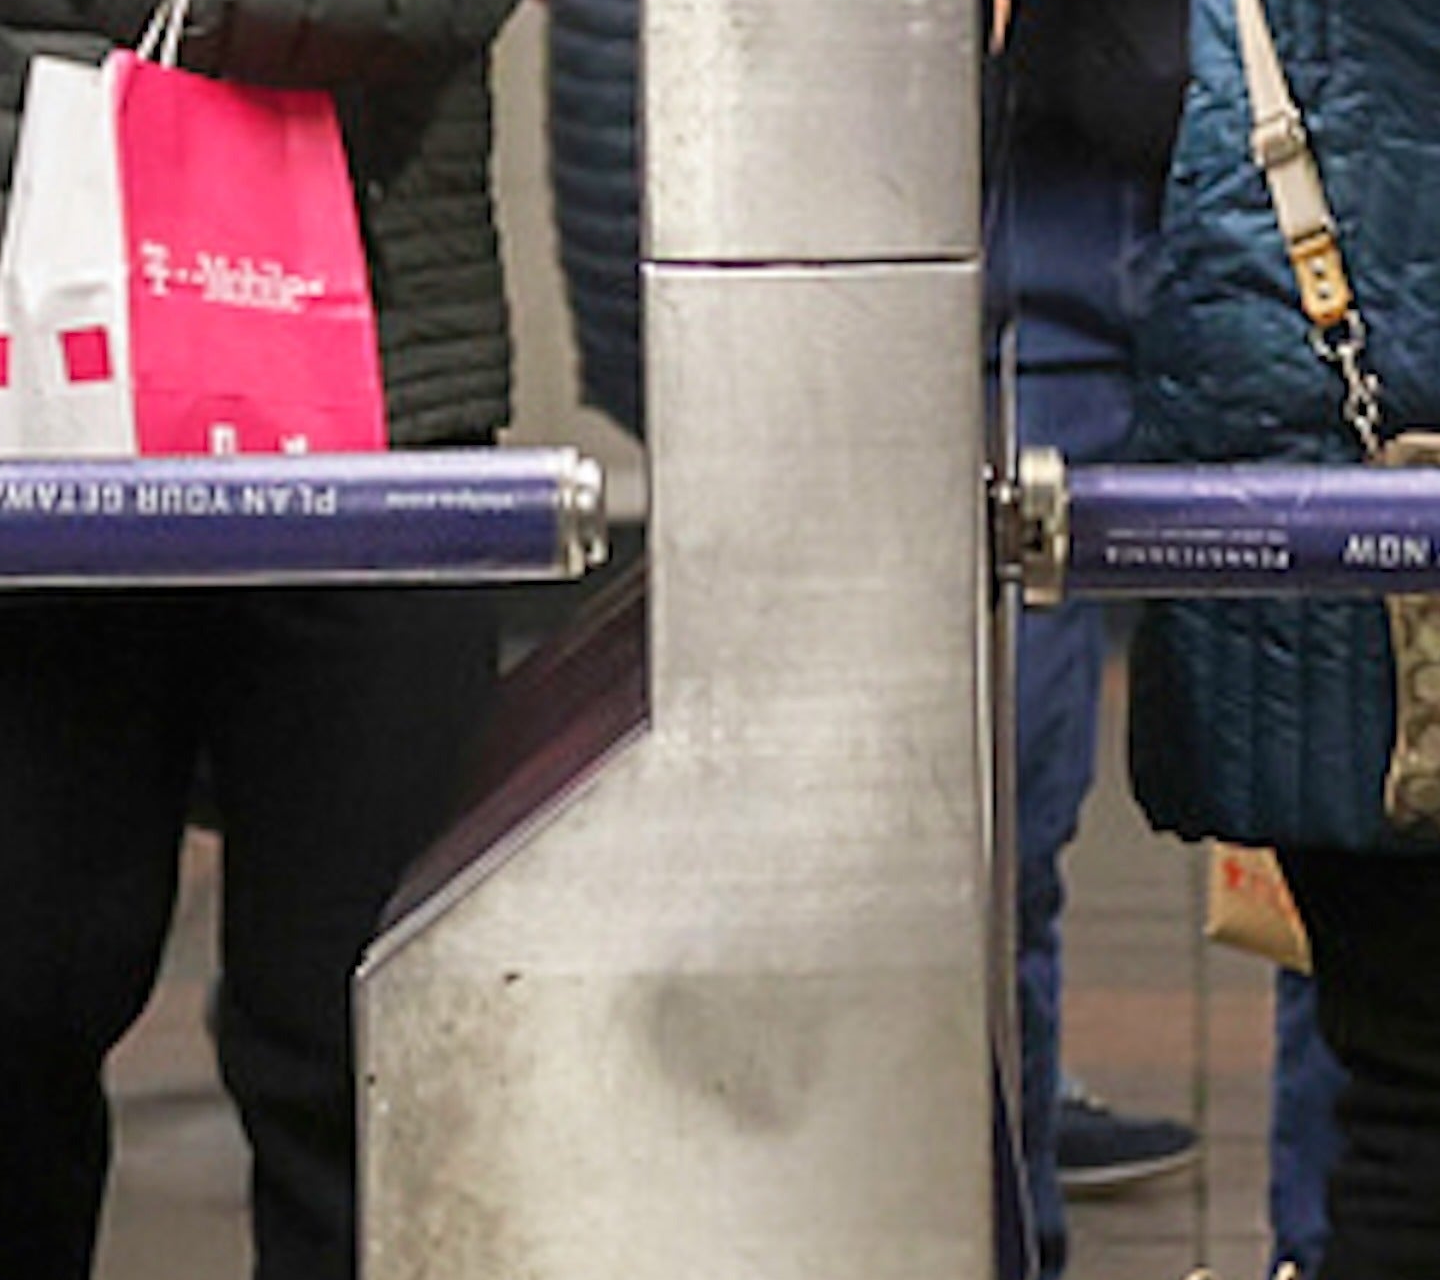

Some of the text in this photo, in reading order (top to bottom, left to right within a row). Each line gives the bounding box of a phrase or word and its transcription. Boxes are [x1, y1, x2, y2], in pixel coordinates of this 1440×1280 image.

[137, 483, 229, 515] YOUR
[243, 483, 338, 516] PLAN
[1344, 534, 1428, 567] NOW
